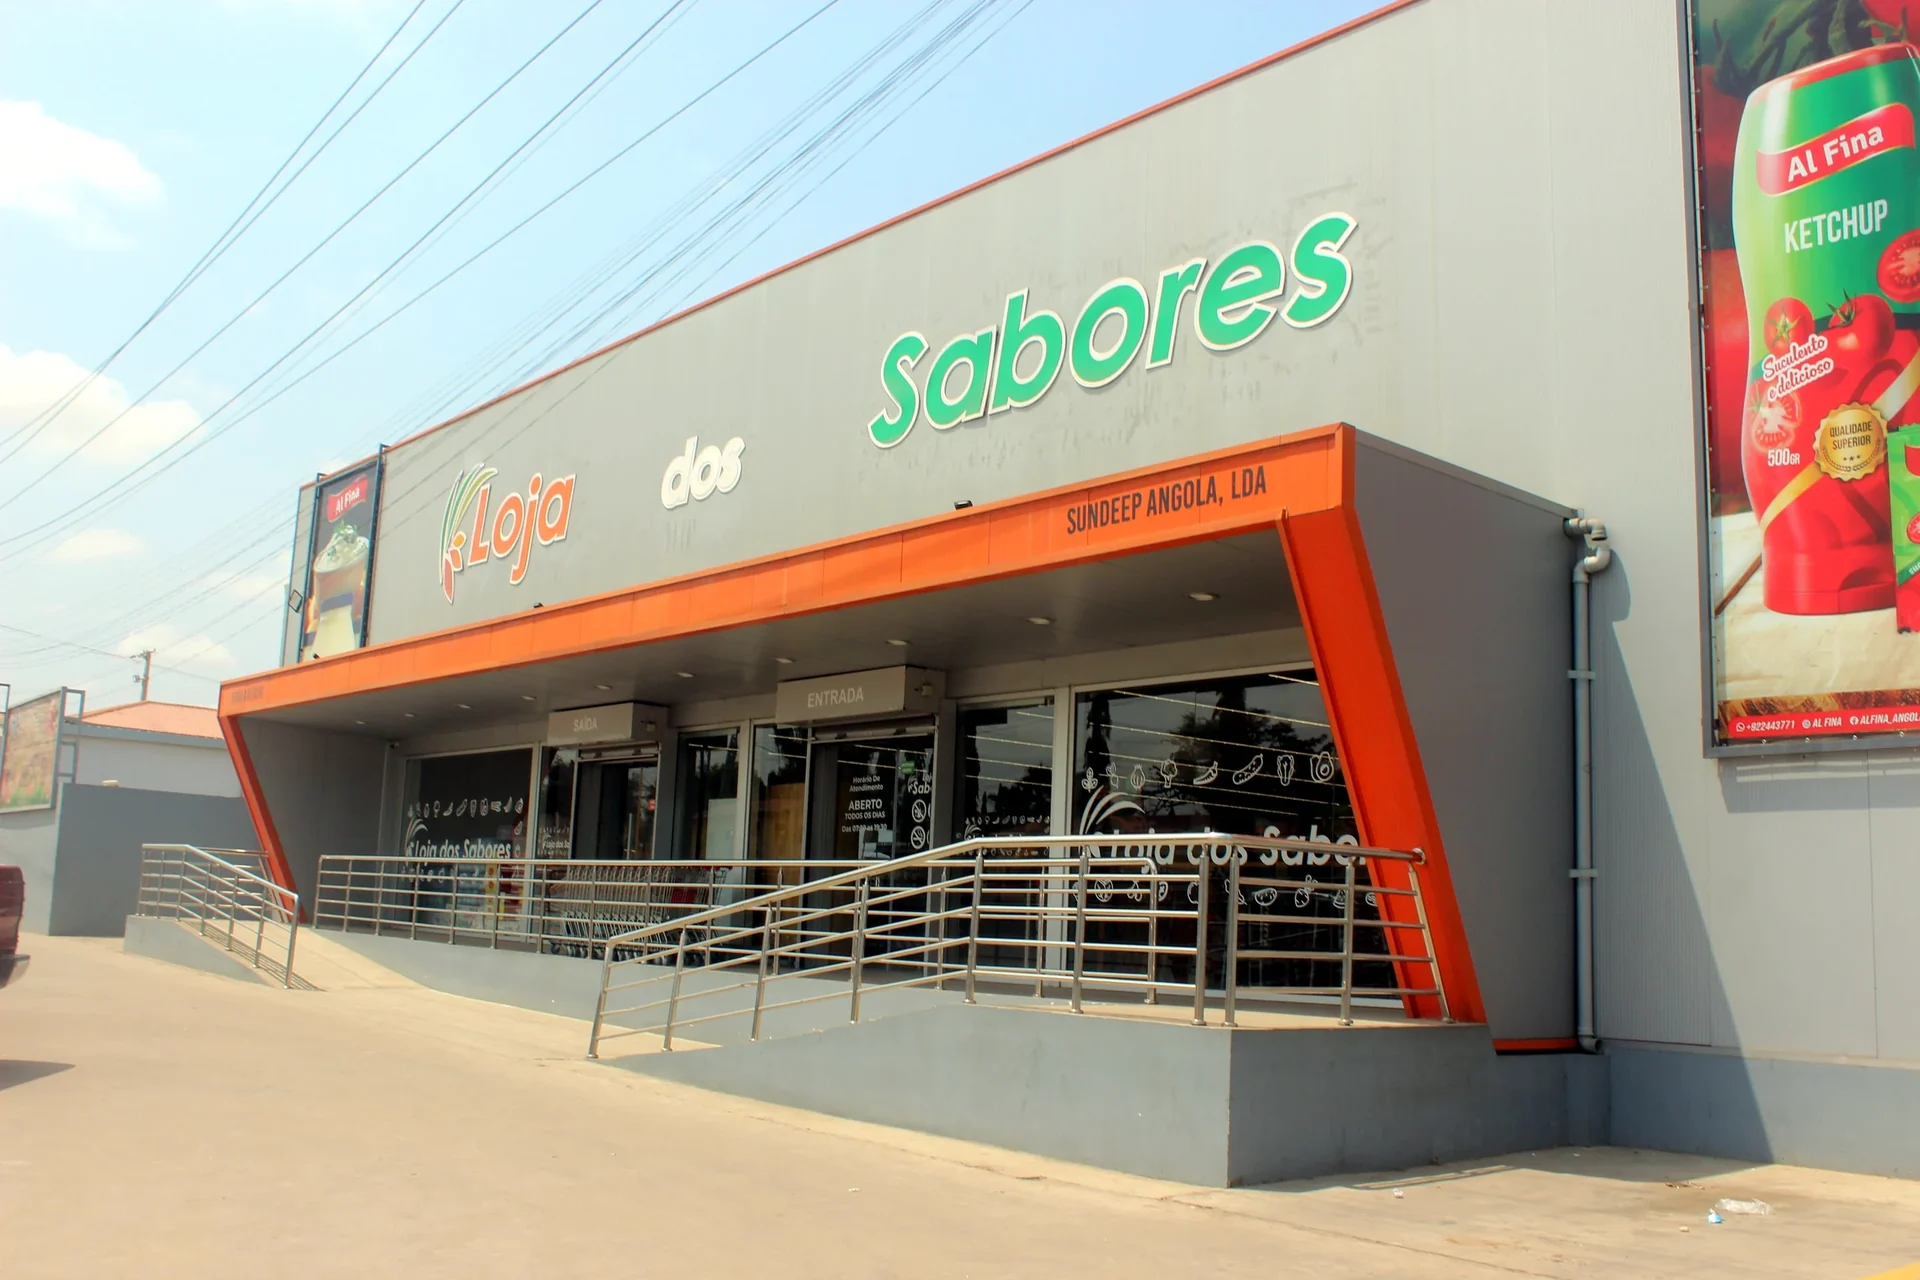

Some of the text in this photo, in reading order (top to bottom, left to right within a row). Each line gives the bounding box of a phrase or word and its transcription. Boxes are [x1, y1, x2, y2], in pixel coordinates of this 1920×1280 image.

[1786, 125, 1885, 182] Al Fina
[1783, 199, 1889, 254] KETCHUP
[867, 211, 1359, 449] Sabores
[1762, 335, 1826, 379] Suculento
[1778, 359, 1832, 393] delicioso
[1829, 421, 1873, 437] QUALIDADE
[1832, 435, 1872, 450] SUPERIOR
[661, 435, 746, 509] dos
[335, 487, 360, 516] Al Fina
[1066, 465, 1267, 535] SUNDEEP ANGOLA, LDA
[467, 472, 577, 585] Loja
[807, 686, 864, 709] ENTRADA
[1746, 711, 1920, 732] +922443771 AL FINA ALFINA_ANGOL
[912, 780, 932, 795] Sab
[844, 811, 886, 821] TODOS OS DIAS
[848, 798, 883, 811] ABERTO
[440, 838, 460, 858] dos
[462, 838, 511, 859] Sabores
[1260, 824, 1366, 866] Sabo
